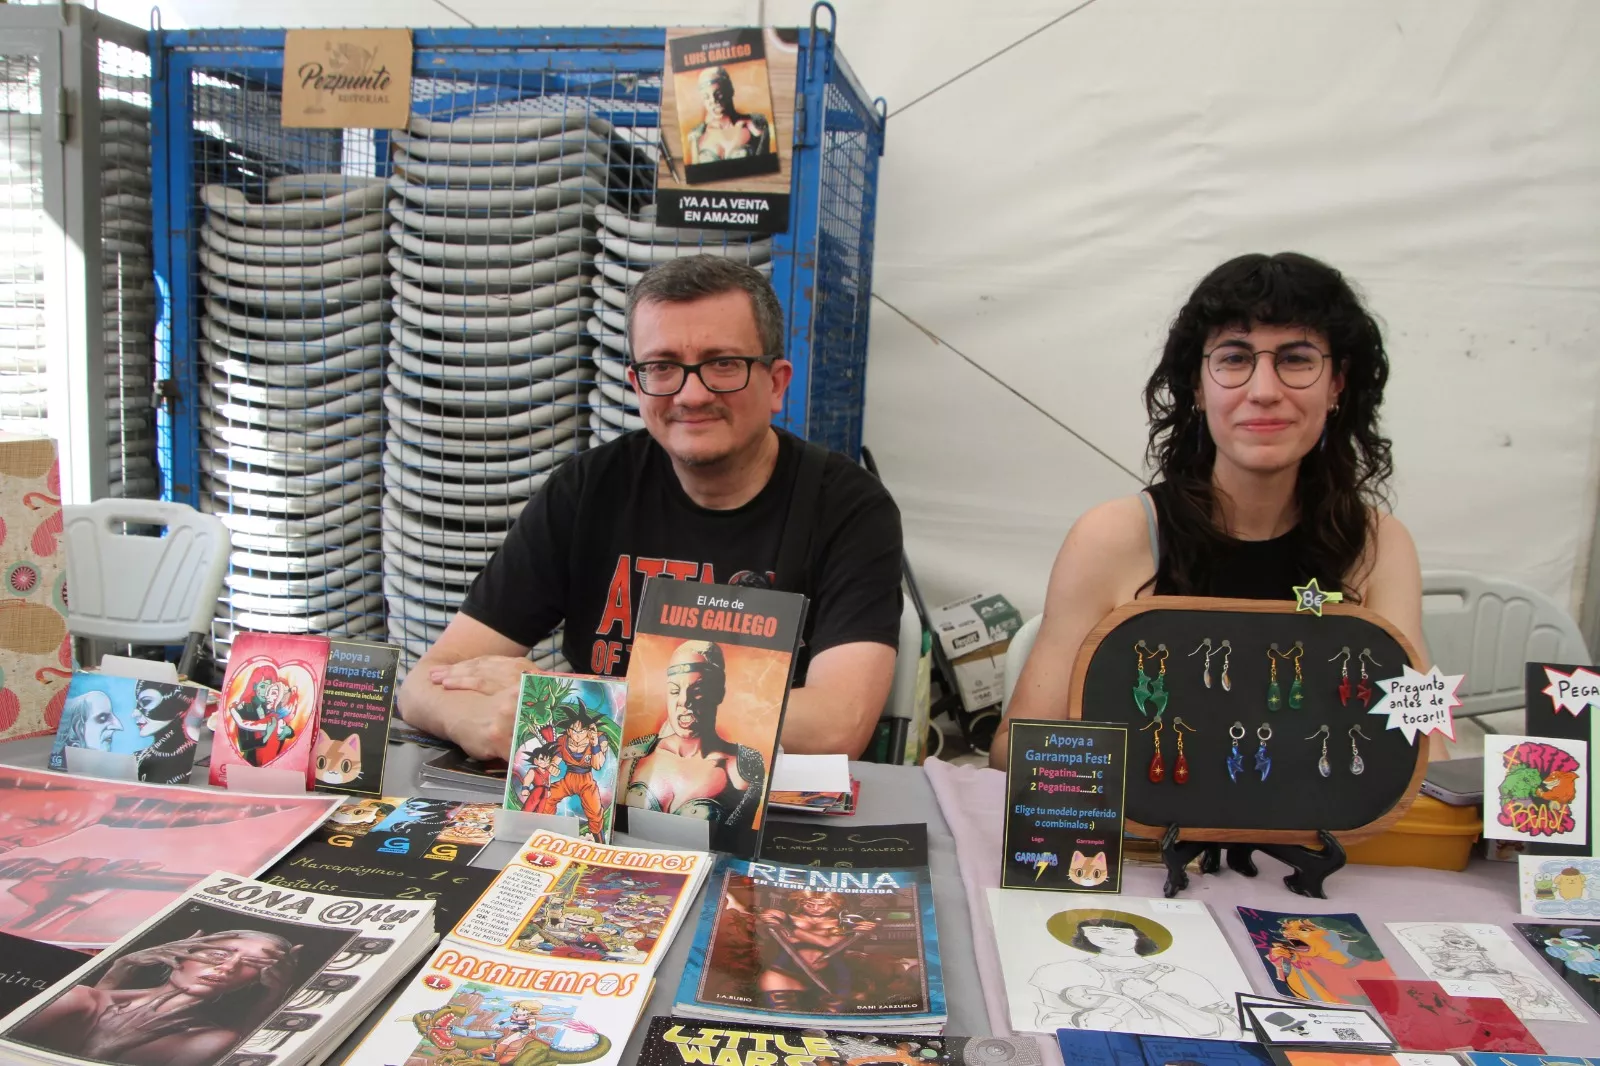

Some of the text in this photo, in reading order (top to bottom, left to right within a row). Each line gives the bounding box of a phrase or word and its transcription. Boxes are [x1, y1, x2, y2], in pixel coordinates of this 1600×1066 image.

[684, 43, 752, 66] LUIS GALLEGO
[299, 62, 392, 95] Pezpunte
[698, 198, 709, 208] A
[711, 198, 728, 209] LA
[730, 199, 770, 210] VENTA
[684, 211, 759, 225] EN AMAZON!
[697, 595, 745, 610] El Arte de
[1303, 590, 1322, 607] 8€
[660, 604, 778, 638] LUIS GALLEGO
[364, 654, 371, 662] a
[590, 639, 624, 675] OF
[361, 667, 385, 679] Fest!
[1391, 674, 1445, 701] Pregunta
[1389, 692, 1443, 709] antes de
[1402, 710, 1446, 725] tocar!!
[1044, 734, 1094, 748] ¡Apoya a
[1025, 749, 1112, 765] Garrampa Fest!
[1032, 767, 1037, 776] 1
[1030, 782, 1037, 791] 2
[1015, 805, 1117, 819] Elige tu modelo preferido
[531, 833, 697, 873] PASATIEMPOS
[266, 875, 339, 892] Postales
[746, 861, 901, 889] RENNA
[753, 878, 768, 886] EN
[773, 880, 811, 891] TIERRA
[203, 877, 420, 926] ZONA @fter
[434, 949, 640, 997] PASATIEMPOS
[662, 1024, 841, 1058] LITTLE
